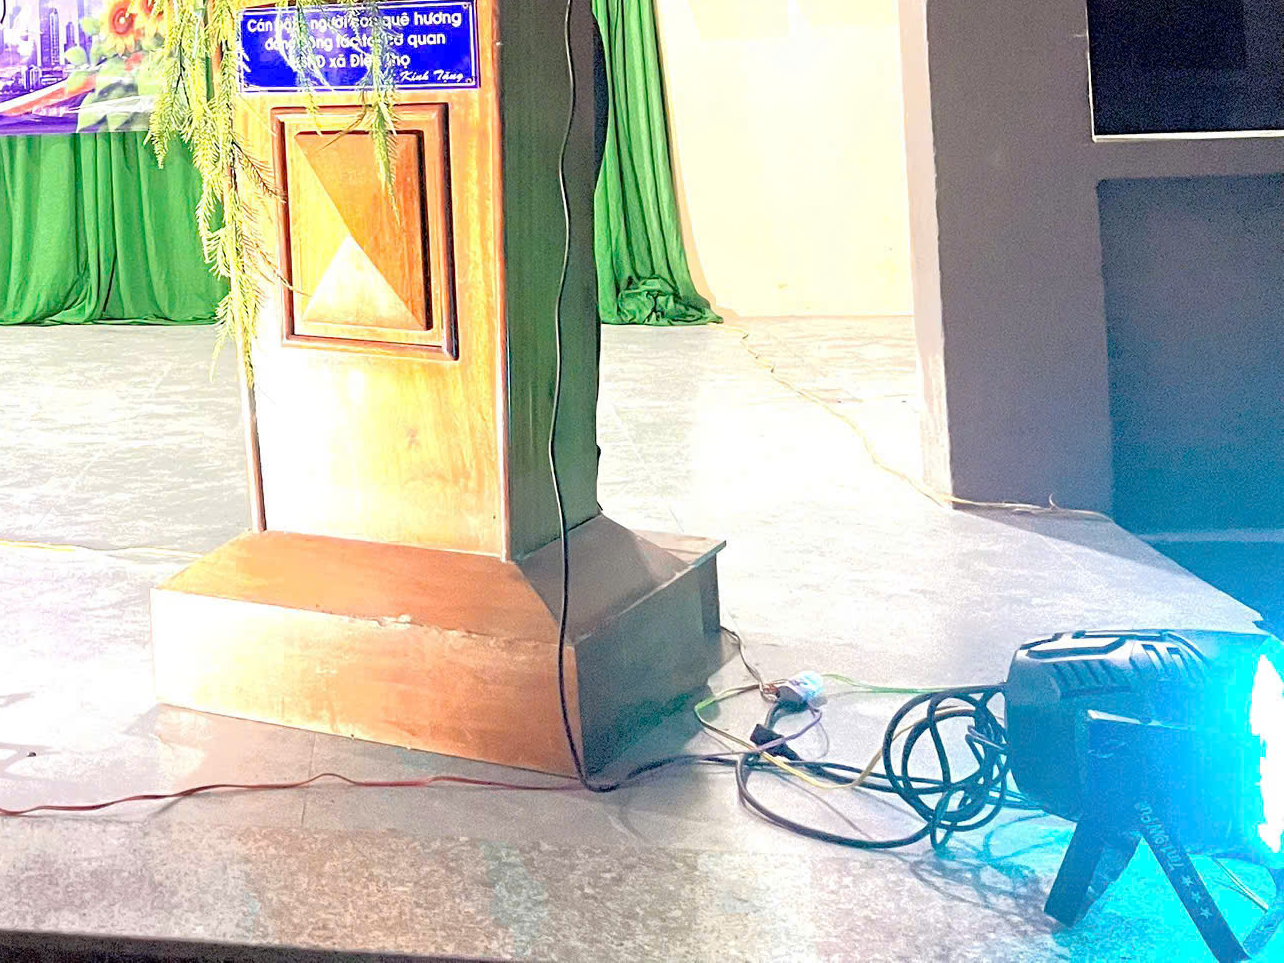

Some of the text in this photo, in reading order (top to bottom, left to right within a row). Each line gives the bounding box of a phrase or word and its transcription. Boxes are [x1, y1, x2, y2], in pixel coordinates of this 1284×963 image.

[247, 18, 273, 33] Cán
[382, 12, 410, 29] quê
[414, 11, 462, 27] hương
[407, 33, 446, 48] quan
[329, 54, 347, 68] xã
